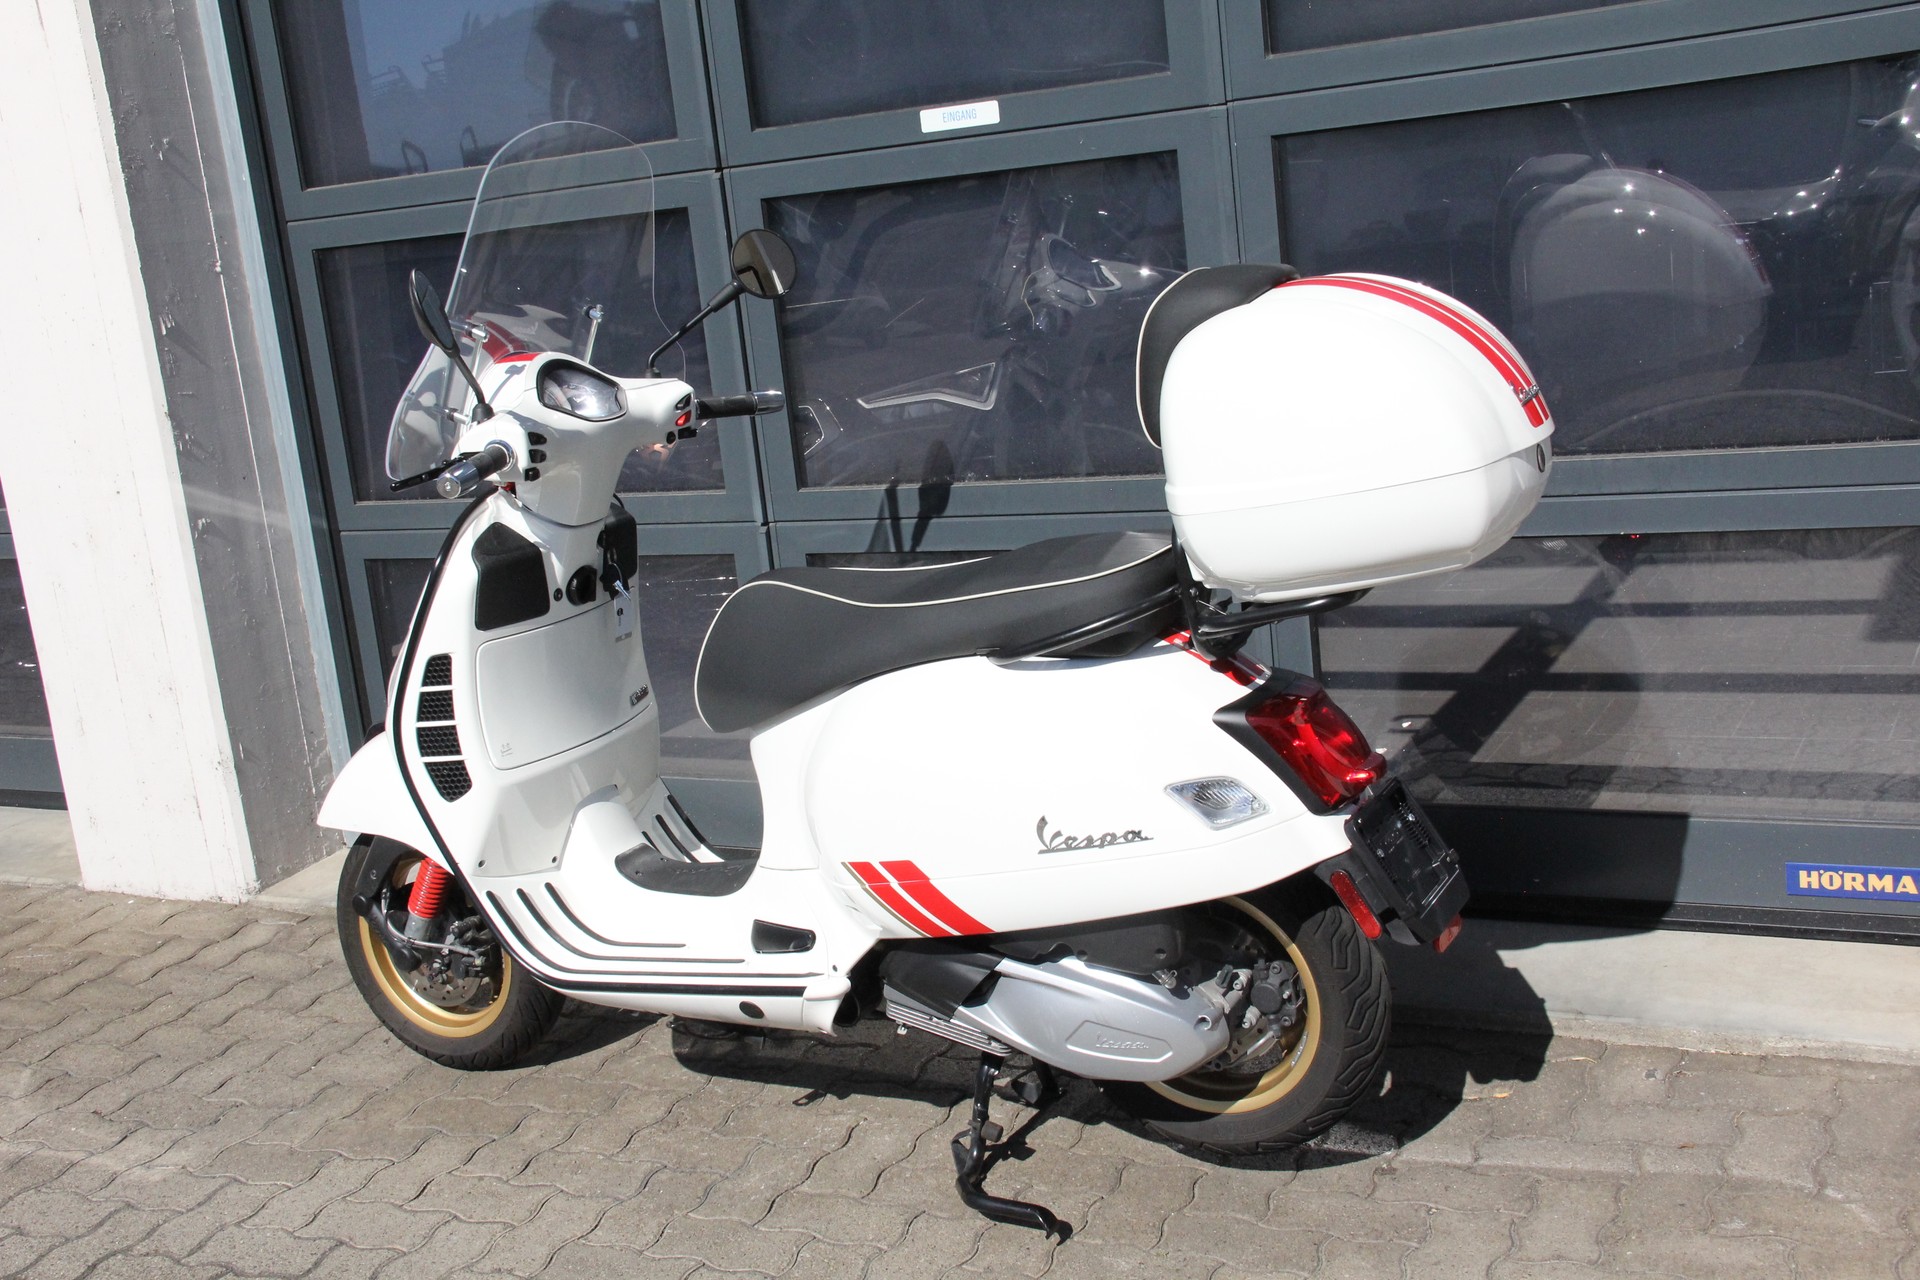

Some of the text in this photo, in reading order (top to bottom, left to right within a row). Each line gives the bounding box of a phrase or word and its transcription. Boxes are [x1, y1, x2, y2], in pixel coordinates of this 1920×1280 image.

[942, 108, 977, 123] EINGANG
[1036, 815, 1154, 855] Vespa
[1798, 869, 1919, 895] HÖRMA
